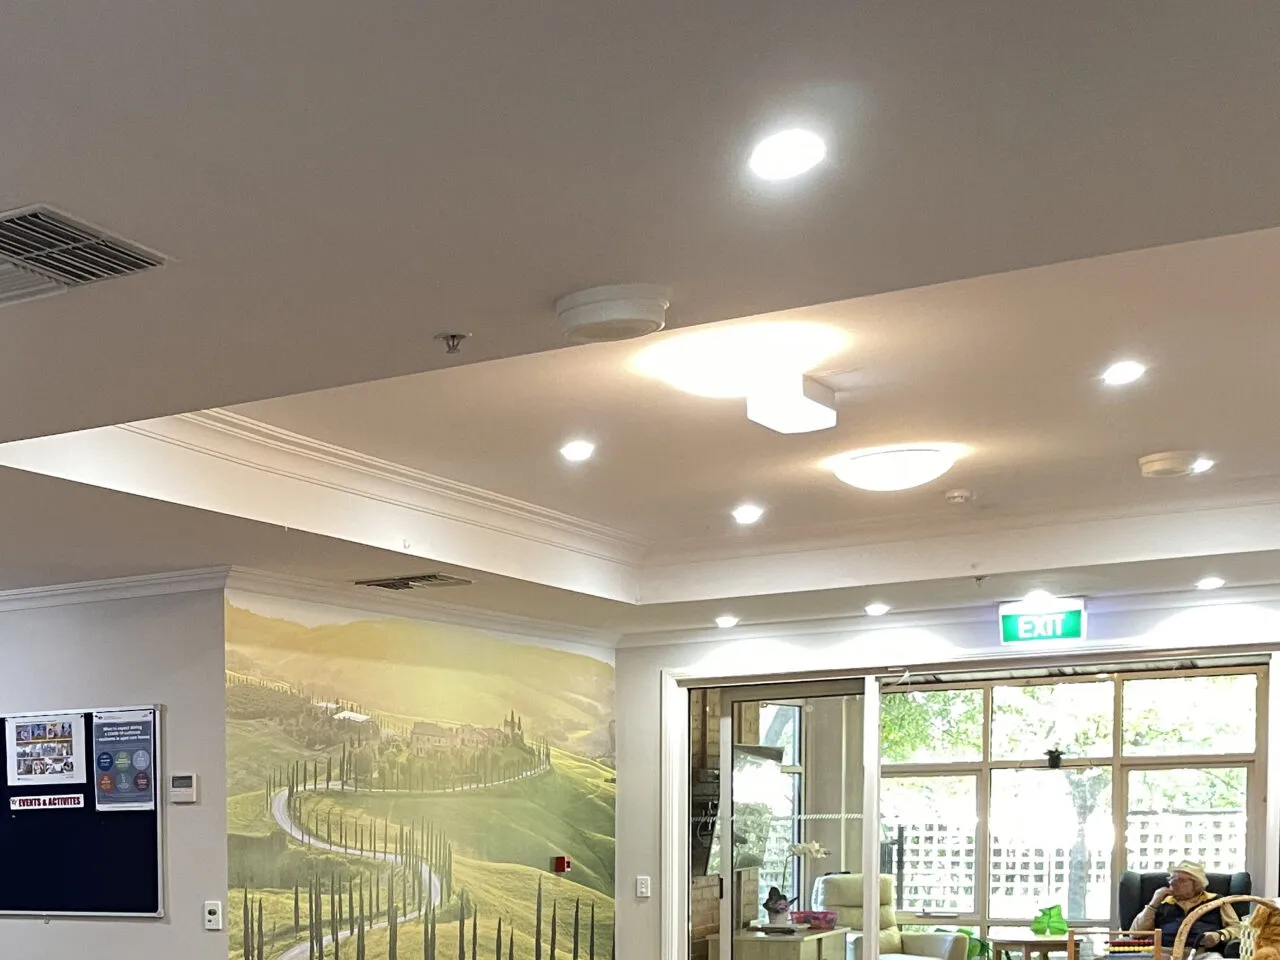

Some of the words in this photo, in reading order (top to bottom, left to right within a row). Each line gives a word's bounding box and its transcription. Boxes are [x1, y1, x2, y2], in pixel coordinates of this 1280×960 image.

[1017, 613, 1065, 638] EXIT
[18, 798, 41, 808] EVENTS
[42, 799, 48, 807] &
